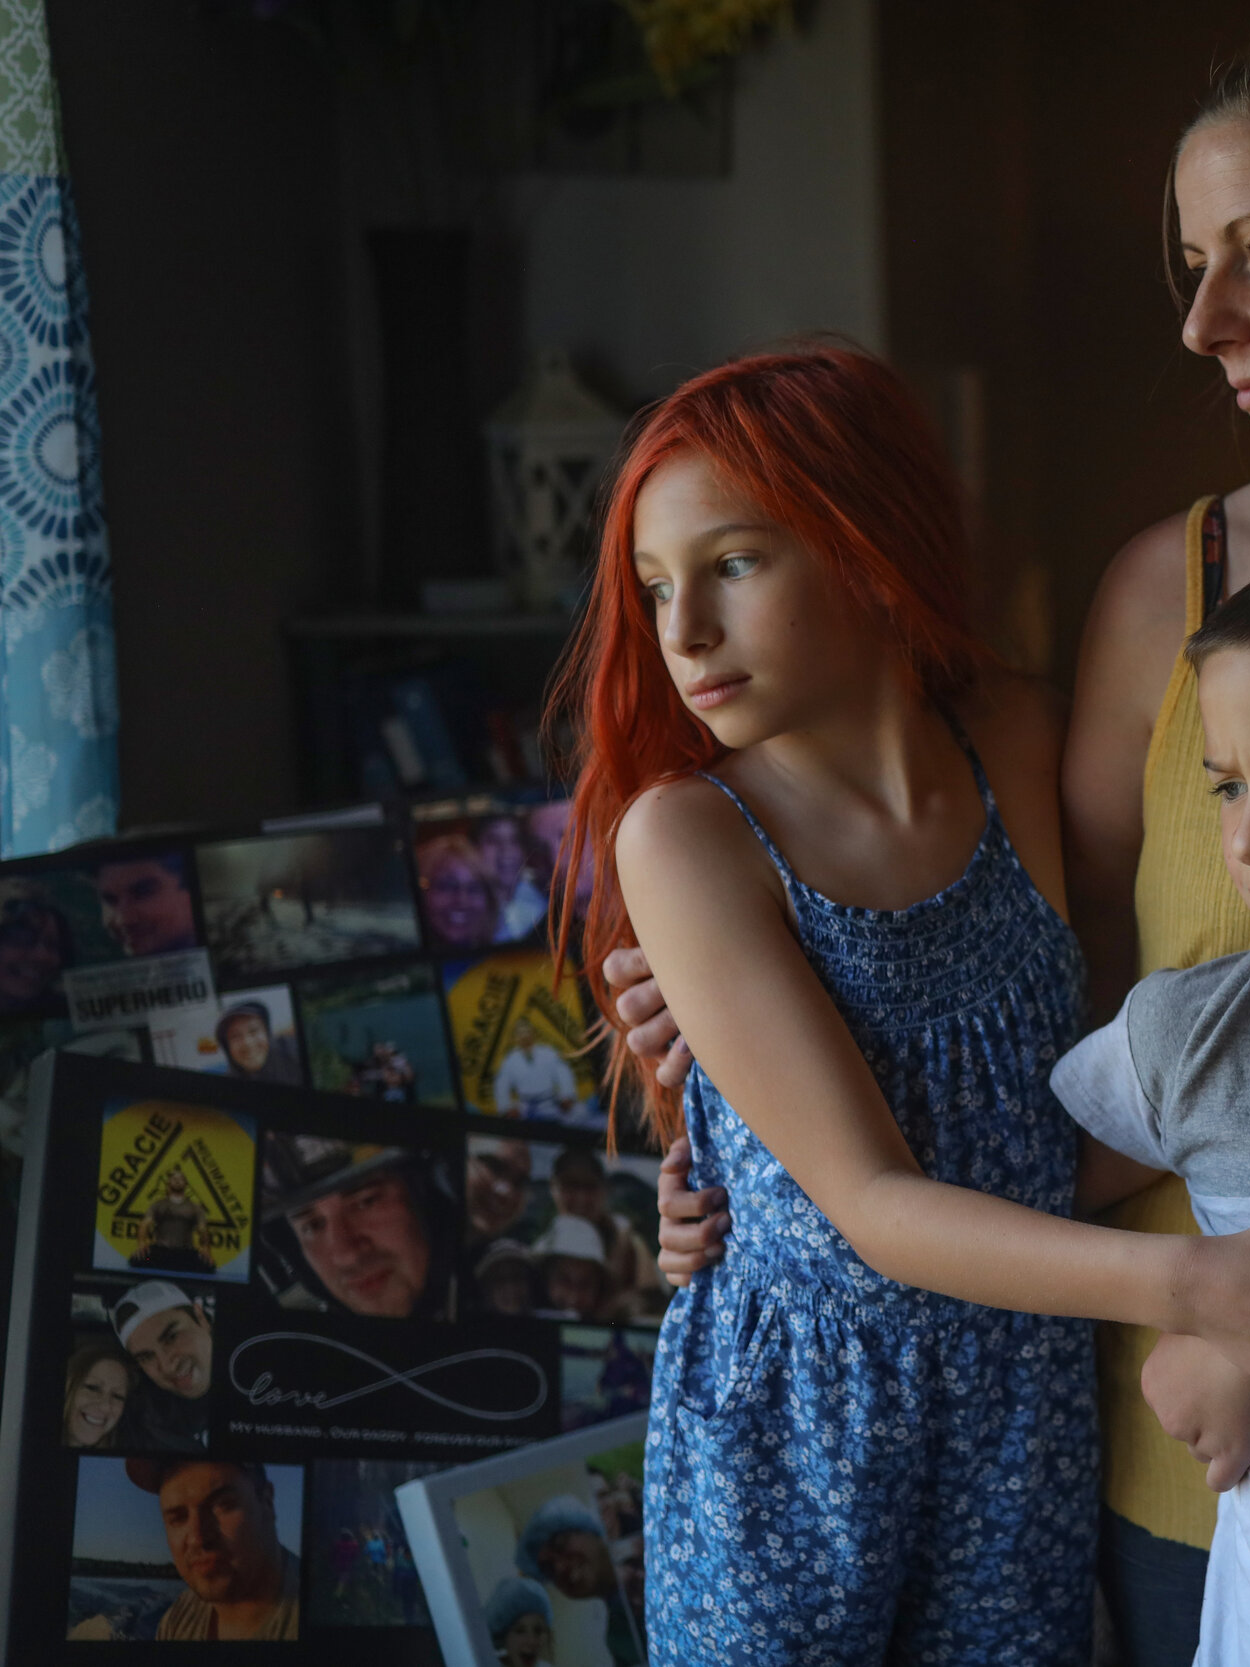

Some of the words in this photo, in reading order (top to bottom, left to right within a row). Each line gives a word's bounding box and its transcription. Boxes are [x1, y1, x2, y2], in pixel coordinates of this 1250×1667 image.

[75, 980, 207, 1022] SUPERHERO
[98, 1112, 171, 1206] GRACIE
[111, 1221, 240, 1249] EDON
[249, 1371, 328, 1409] love
[229, 1420, 251, 1434] MY
